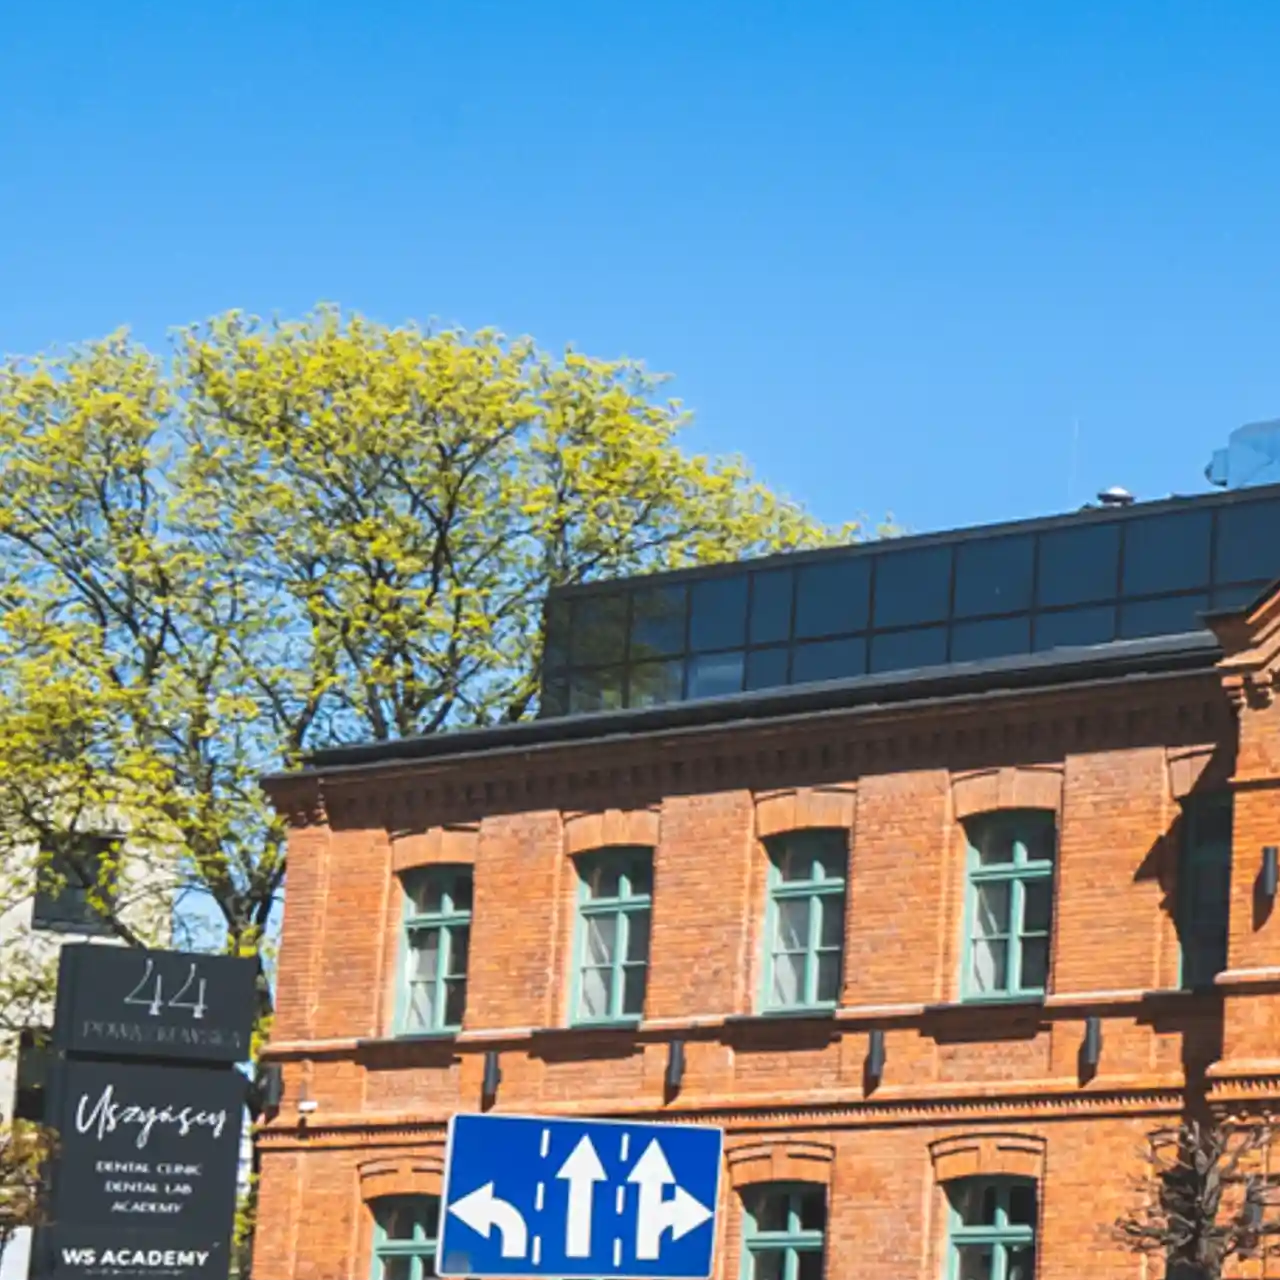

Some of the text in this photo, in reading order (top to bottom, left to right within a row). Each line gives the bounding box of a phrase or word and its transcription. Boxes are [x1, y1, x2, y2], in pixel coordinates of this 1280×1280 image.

[124, 959, 207, 1018] 44
[95, 1160, 149, 1173] DENTAL
[105, 1181, 192, 1194] DENTAL LAB
[111, 1201, 182, 1213] ACADEMY
[62, 1248, 209, 1266] WS ACADEMY
